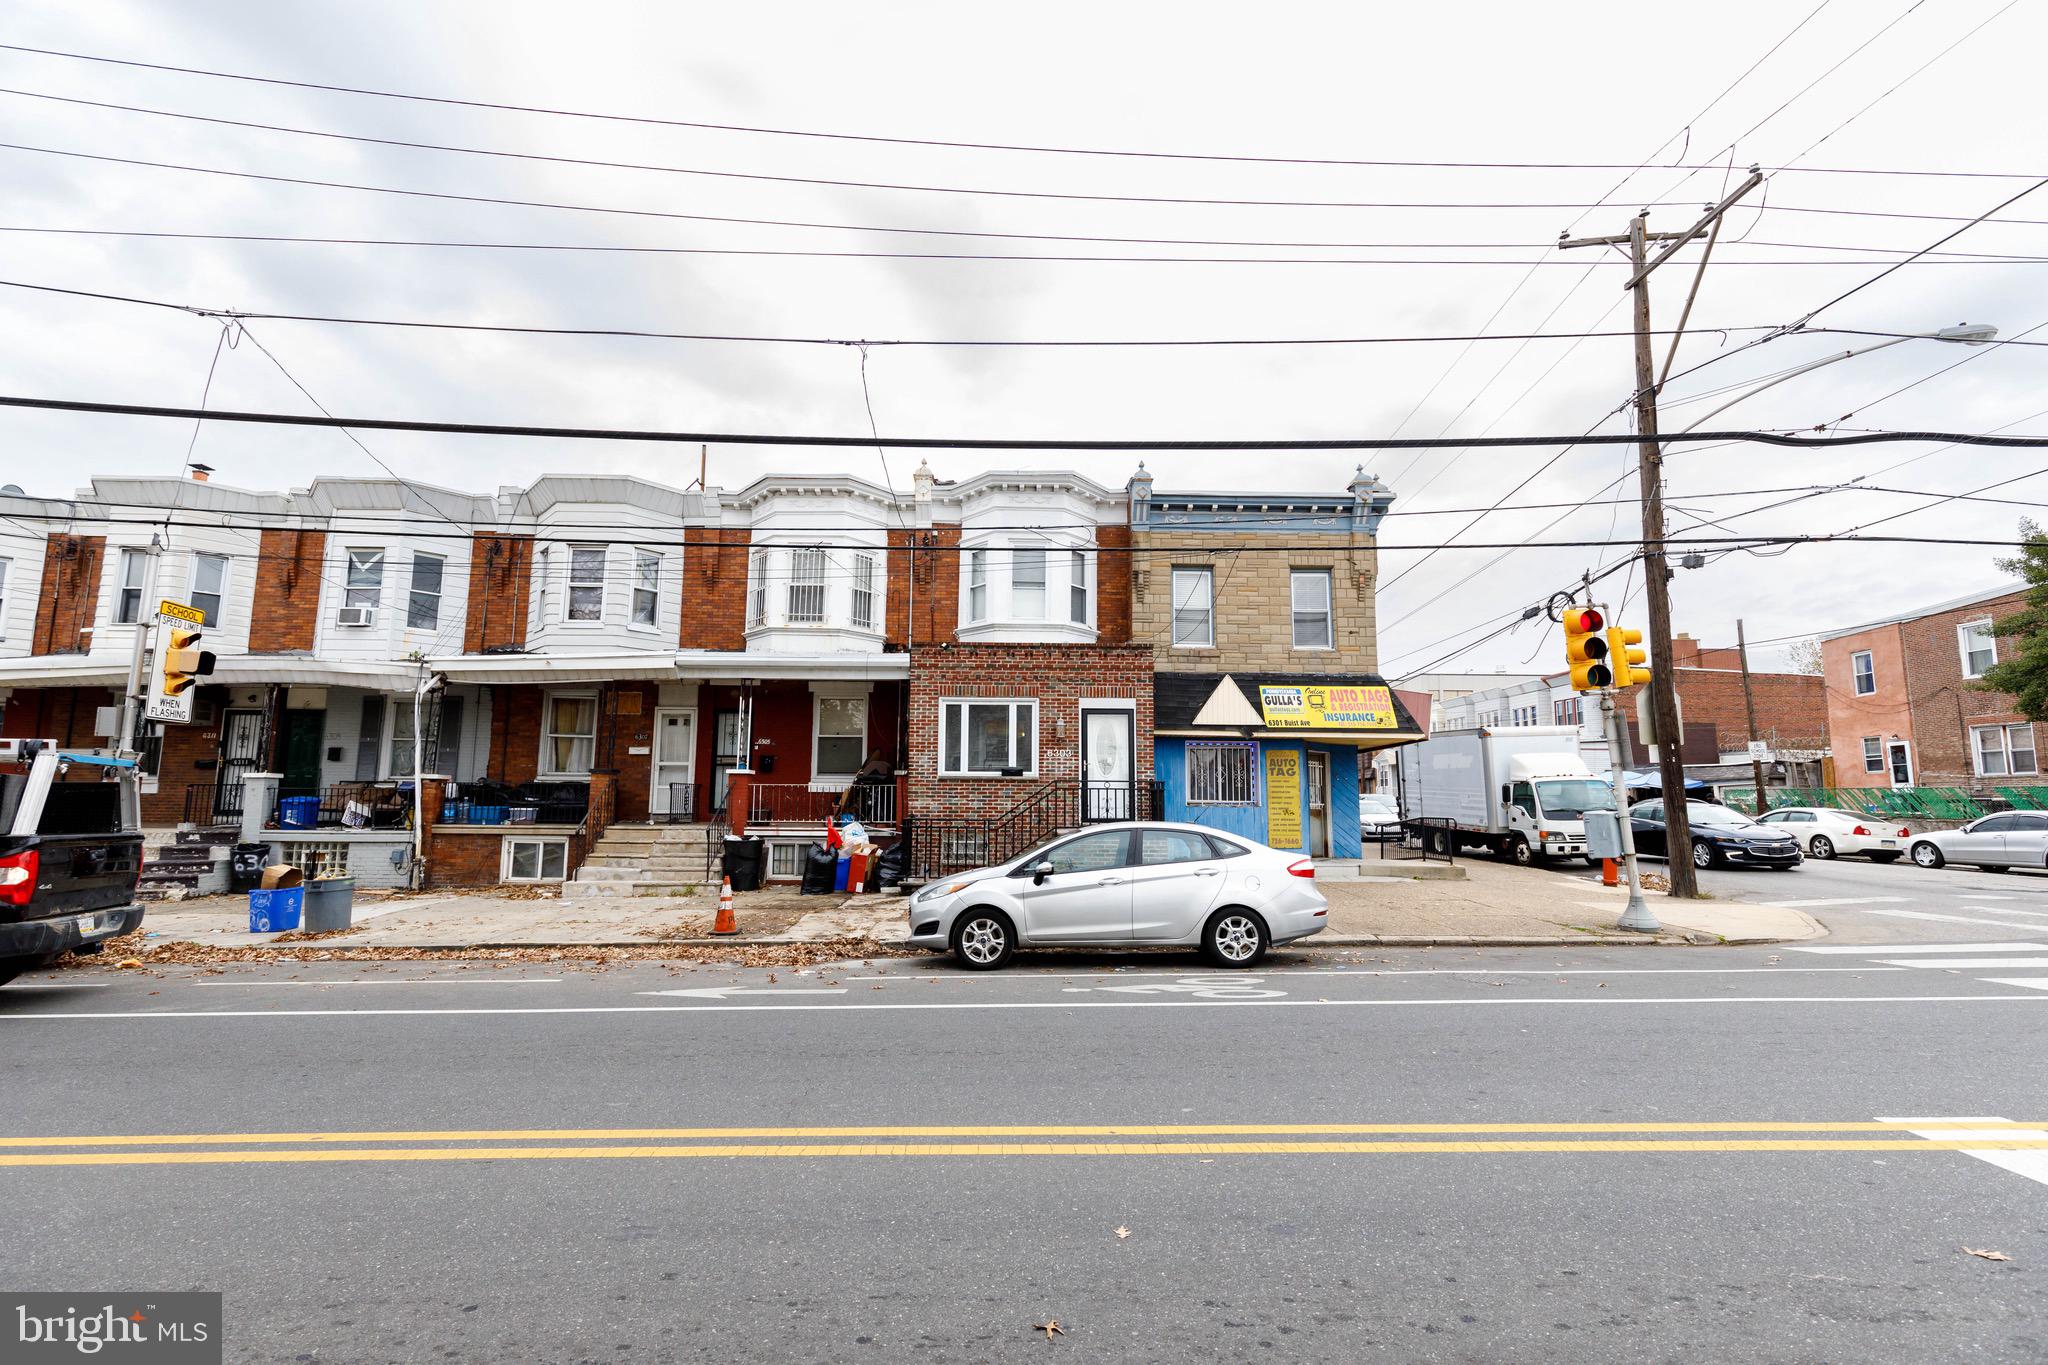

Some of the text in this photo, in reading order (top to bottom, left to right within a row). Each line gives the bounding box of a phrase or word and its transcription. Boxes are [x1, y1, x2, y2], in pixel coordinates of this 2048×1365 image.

[166, 605, 198, 621] SCHOOL
[162, 615, 200, 632] SPEED LIMIT
[1264, 695, 1303, 706] GULLA'S
[1330, 689, 1390, 703] AUTO TAGS
[160, 698, 180, 709] WHEN
[1339, 703, 1391, 712] REGISTRATION
[150, 706, 187, 720] FLASHING
[1323, 712, 1376, 722] INSURANCE
[1268, 719, 1283, 727] 6301
[1300, 719, 1311, 727] Ave
[1047, 749, 1073, 758] 6303
[1269, 758, 1297, 767] AUTO
[1269, 767, 1297, 777] TAG
